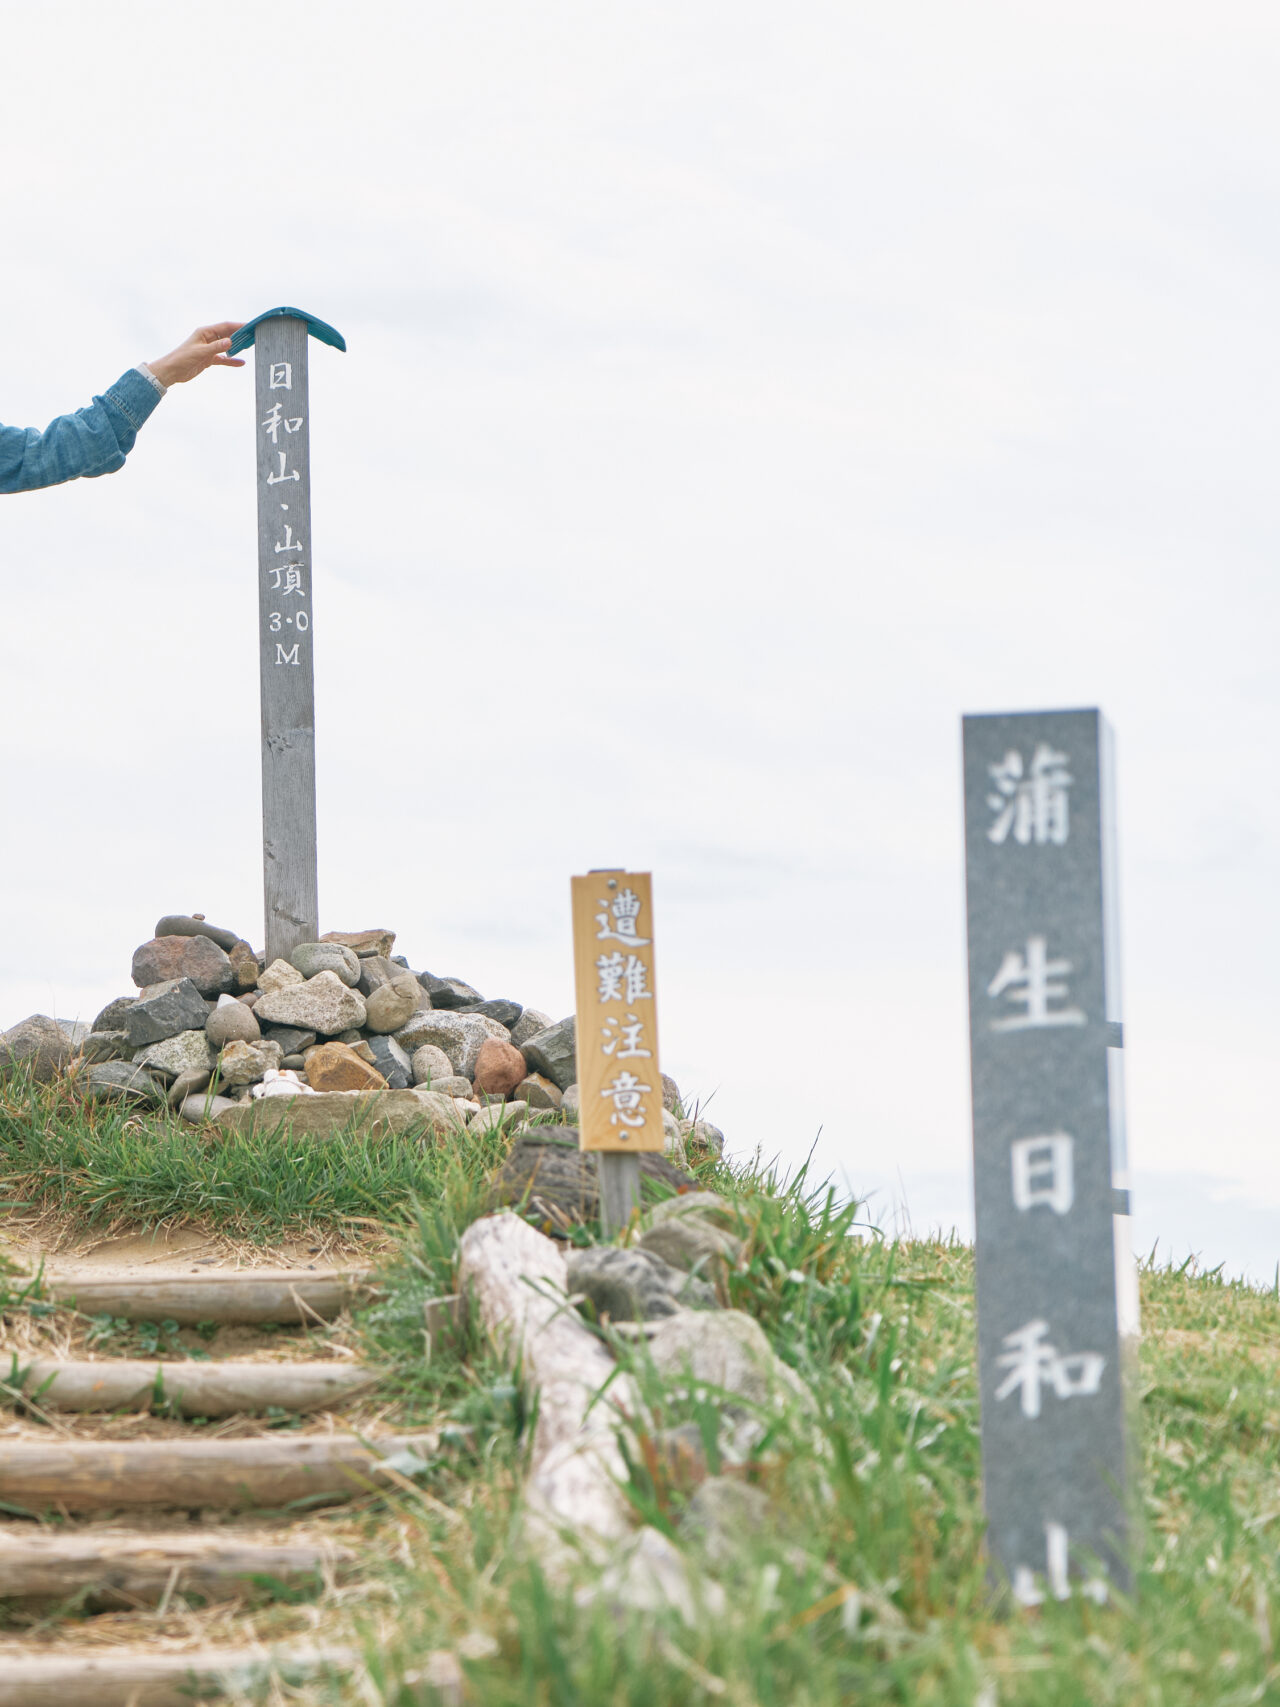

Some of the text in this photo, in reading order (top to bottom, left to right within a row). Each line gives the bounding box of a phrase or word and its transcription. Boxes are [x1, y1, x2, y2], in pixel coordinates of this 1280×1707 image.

[595, 886, 653, 1127] 遭難注意
[985, 746, 1102, 1605] 蒲生日和山
